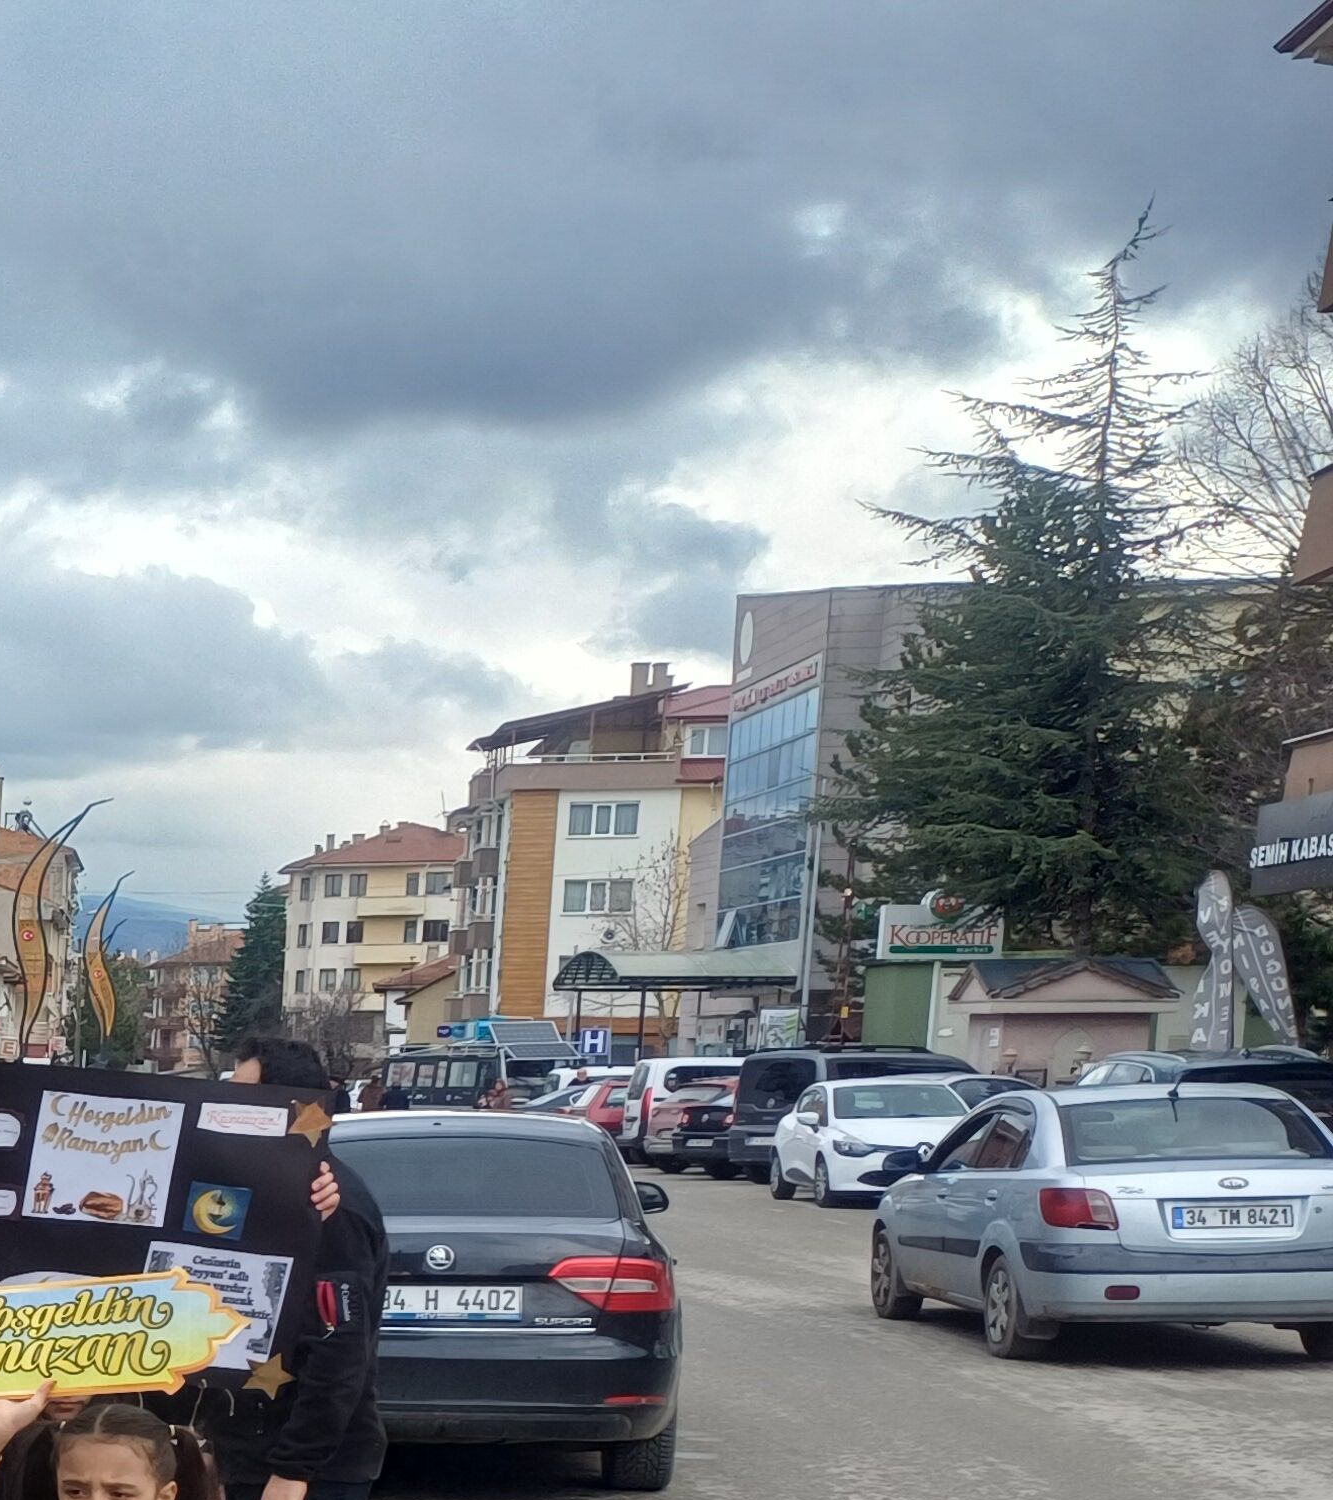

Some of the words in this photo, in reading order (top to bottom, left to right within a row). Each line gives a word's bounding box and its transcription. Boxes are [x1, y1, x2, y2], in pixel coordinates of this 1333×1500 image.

[583, 1030, 605, 1054] H
[53, 1126, 148, 1164] Ramazan
[1185, 1209, 1207, 1226] 34
[1218, 1208, 1241, 1225] TM
[1247, 1207, 1289, 1225] 8421
[424, 1288, 439, 1311] H
[456, 1288, 516, 1312] 4402
